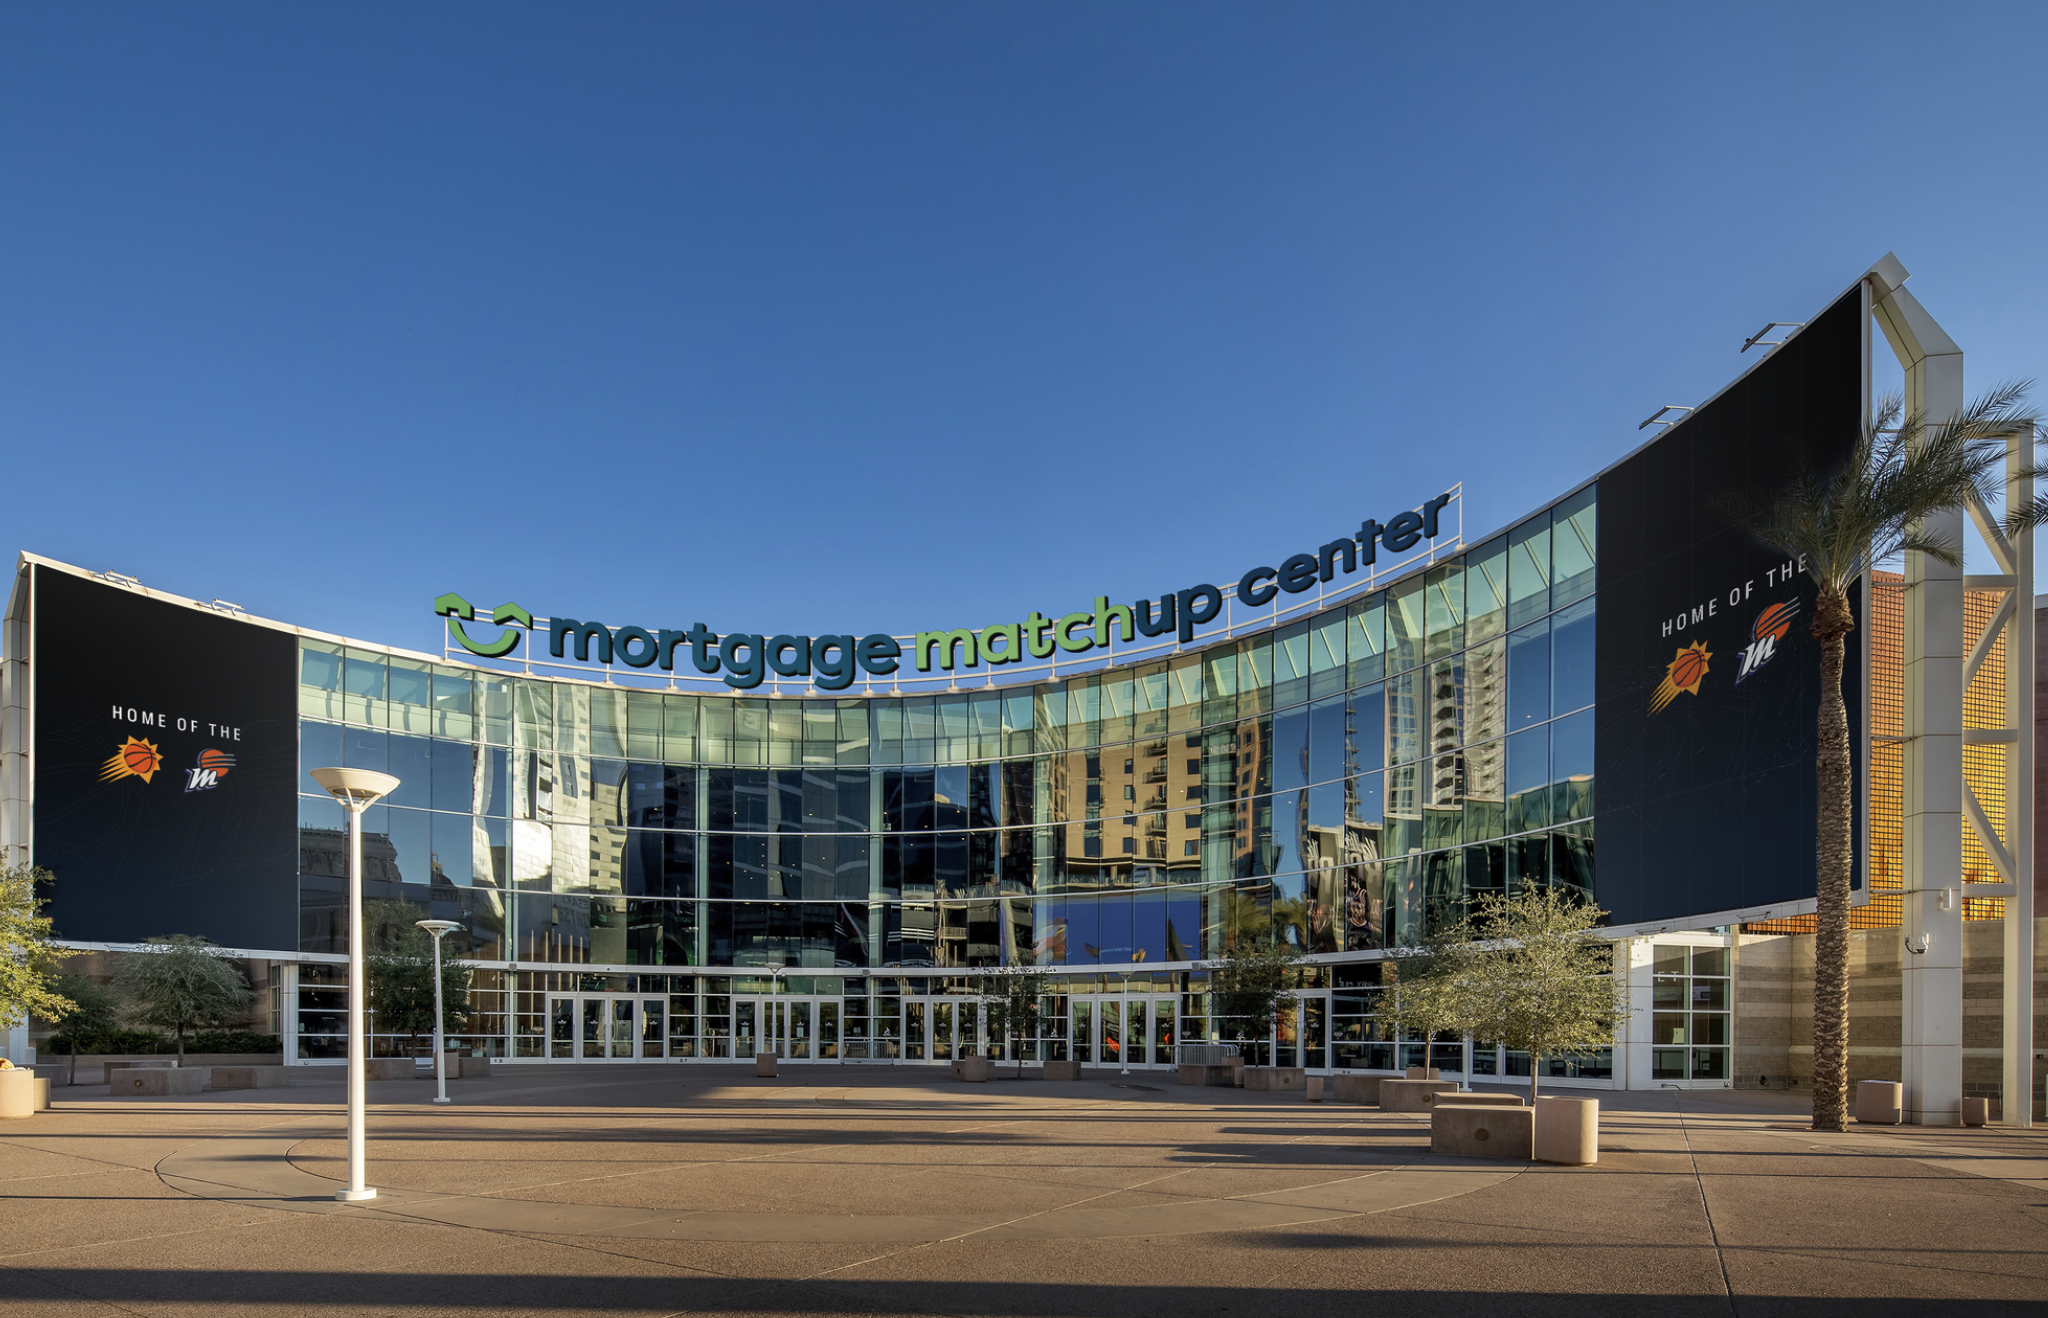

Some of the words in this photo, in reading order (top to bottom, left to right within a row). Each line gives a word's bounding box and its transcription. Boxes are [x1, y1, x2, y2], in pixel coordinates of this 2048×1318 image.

[550, 616, 902, 691] mortgage
[916, 583, 1223, 671] matchup
[1237, 493, 1451, 607] center
[1662, 598, 1718, 638] HOME
[1729, 580, 1754, 606] OF
[1766, 552, 1808, 588] THE
[112, 704, 167, 728] HOME
[177, 717, 198, 733] OF
[208, 723, 241, 742] THE
